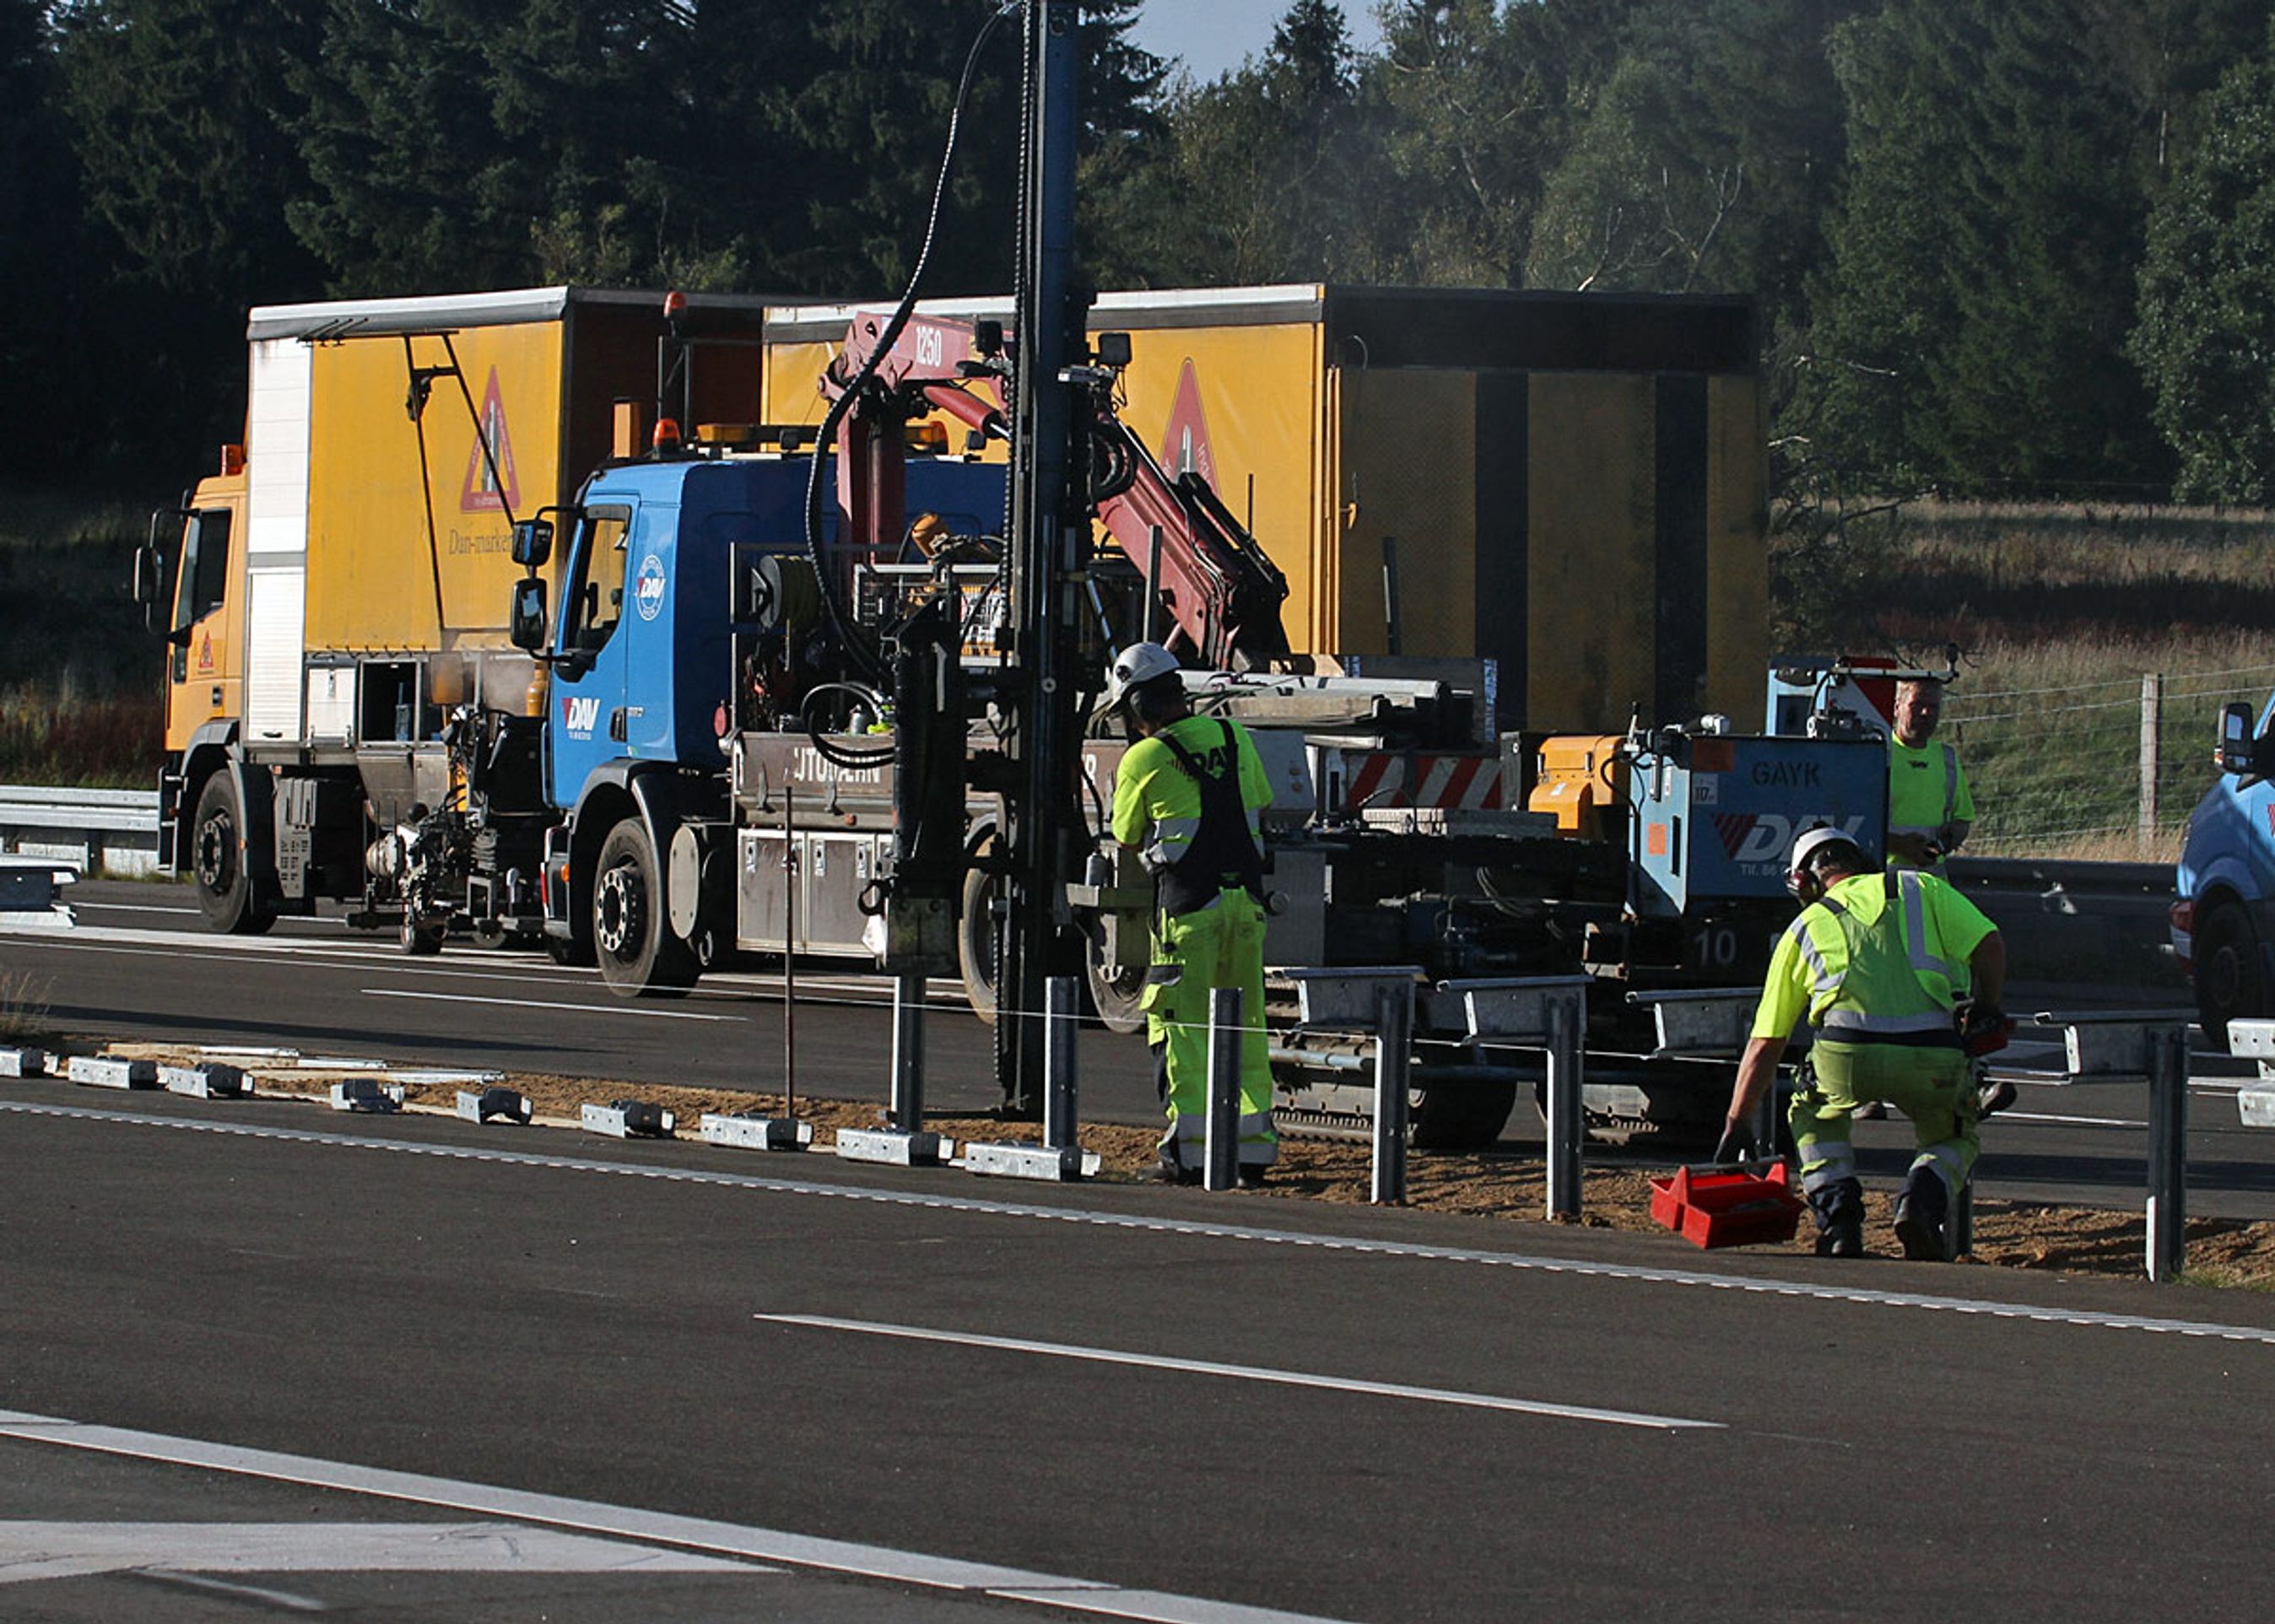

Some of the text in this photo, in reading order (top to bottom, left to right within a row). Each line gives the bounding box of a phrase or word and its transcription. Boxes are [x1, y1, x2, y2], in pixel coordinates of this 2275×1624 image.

[916, 326, 942, 366] 1250
[640, 578, 666, 598] DAV
[567, 698, 600, 731] DAV
[1752, 761, 1820, 786] GAYK
[1694, 929, 1737, 966] 10
